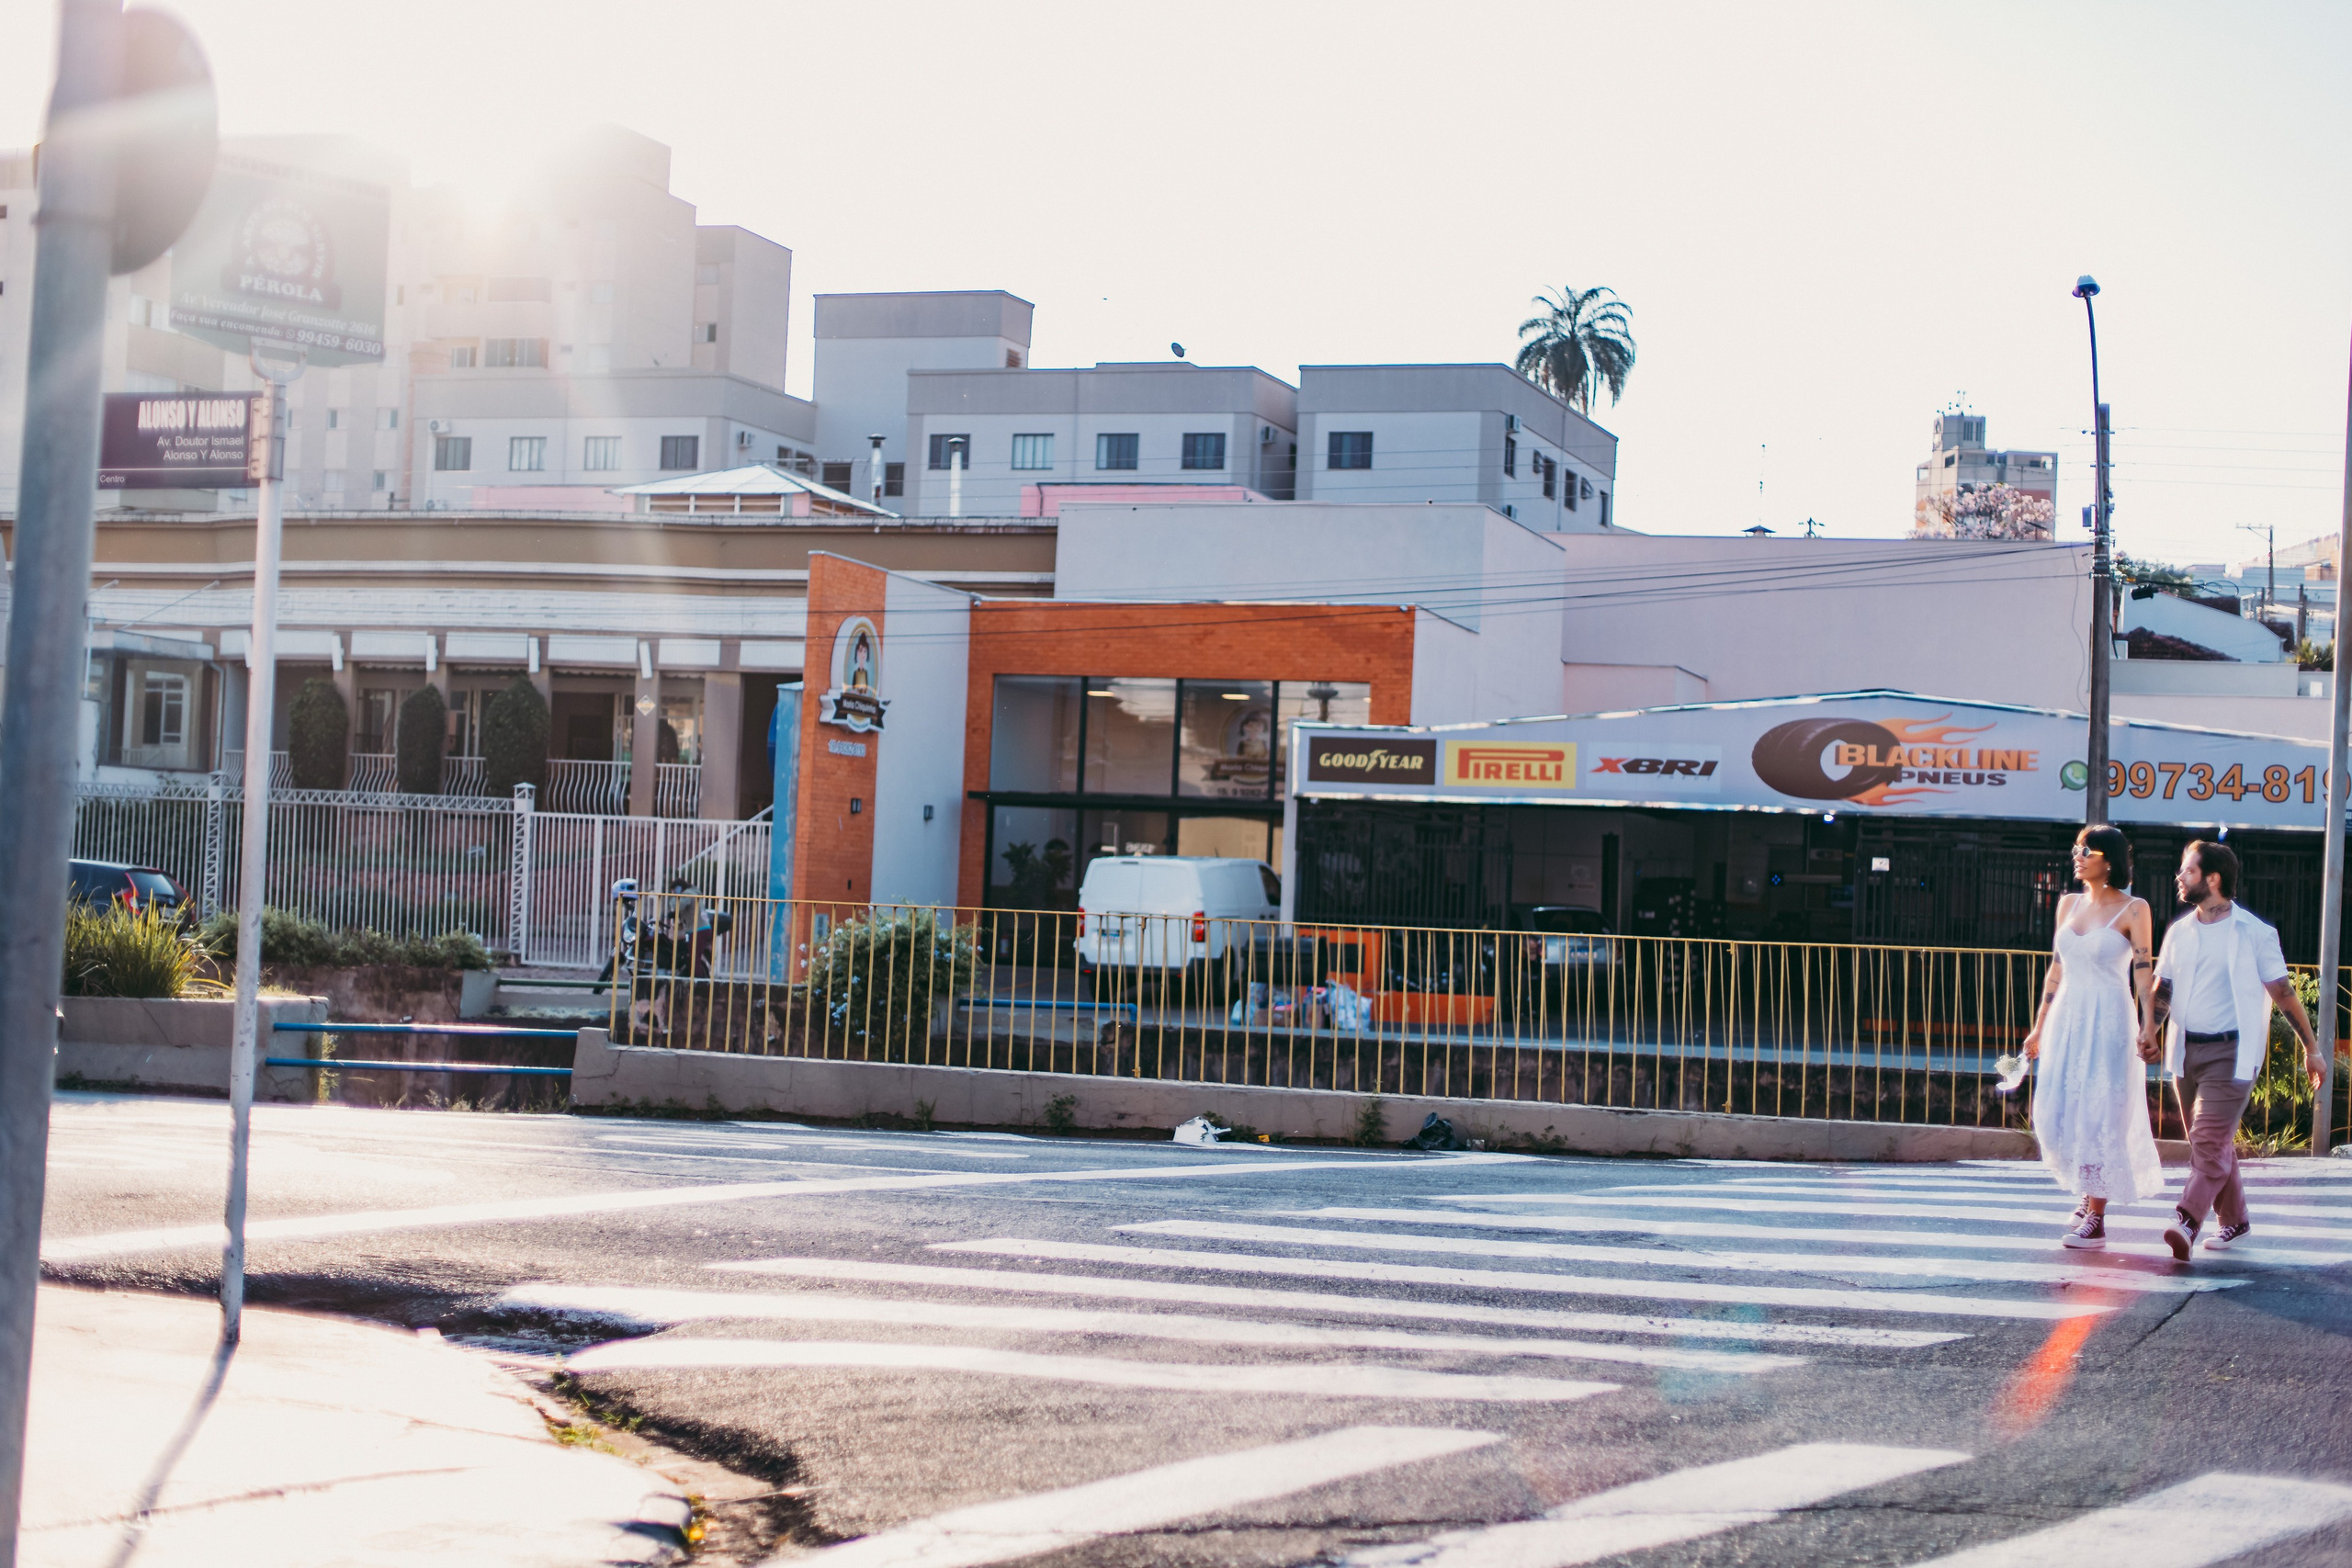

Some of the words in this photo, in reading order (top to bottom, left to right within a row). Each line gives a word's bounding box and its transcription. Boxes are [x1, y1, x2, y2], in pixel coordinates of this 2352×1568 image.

[239, 275, 323, 301] PÉROLA
[202, 294, 259, 314] Vereador
[260, 305, 287, 320] José
[288, 310, 346, 331] Granzotte
[170, 310, 196, 322] Faça
[198, 315, 218, 326] sua
[220, 319, 285, 336] encomenda:
[296, 329, 381, 355] 99459-6030
[138, 400, 186, 428] ALONSO
[187, 400, 197, 427] Y
[198, 399, 245, 428] ALONSO
[157, 436, 172, 446] Av.
[175, 436, 208, 446] Doutor
[211, 435, 243, 446] Ismael
[163, 449, 198, 460] Alonso
[200, 449, 208, 459] Y
[209, 449, 243, 460] Alonso
[99, 474, 125, 483] Centro
[1319, 750, 1423, 772] GOODYEAR
[1457, 748, 1565, 782] PIRELLI
[1589, 757, 1719, 776] XBRI
[1835, 743, 2040, 772] BLACKLINE
[1894, 770, 2007, 786] PNEUS
